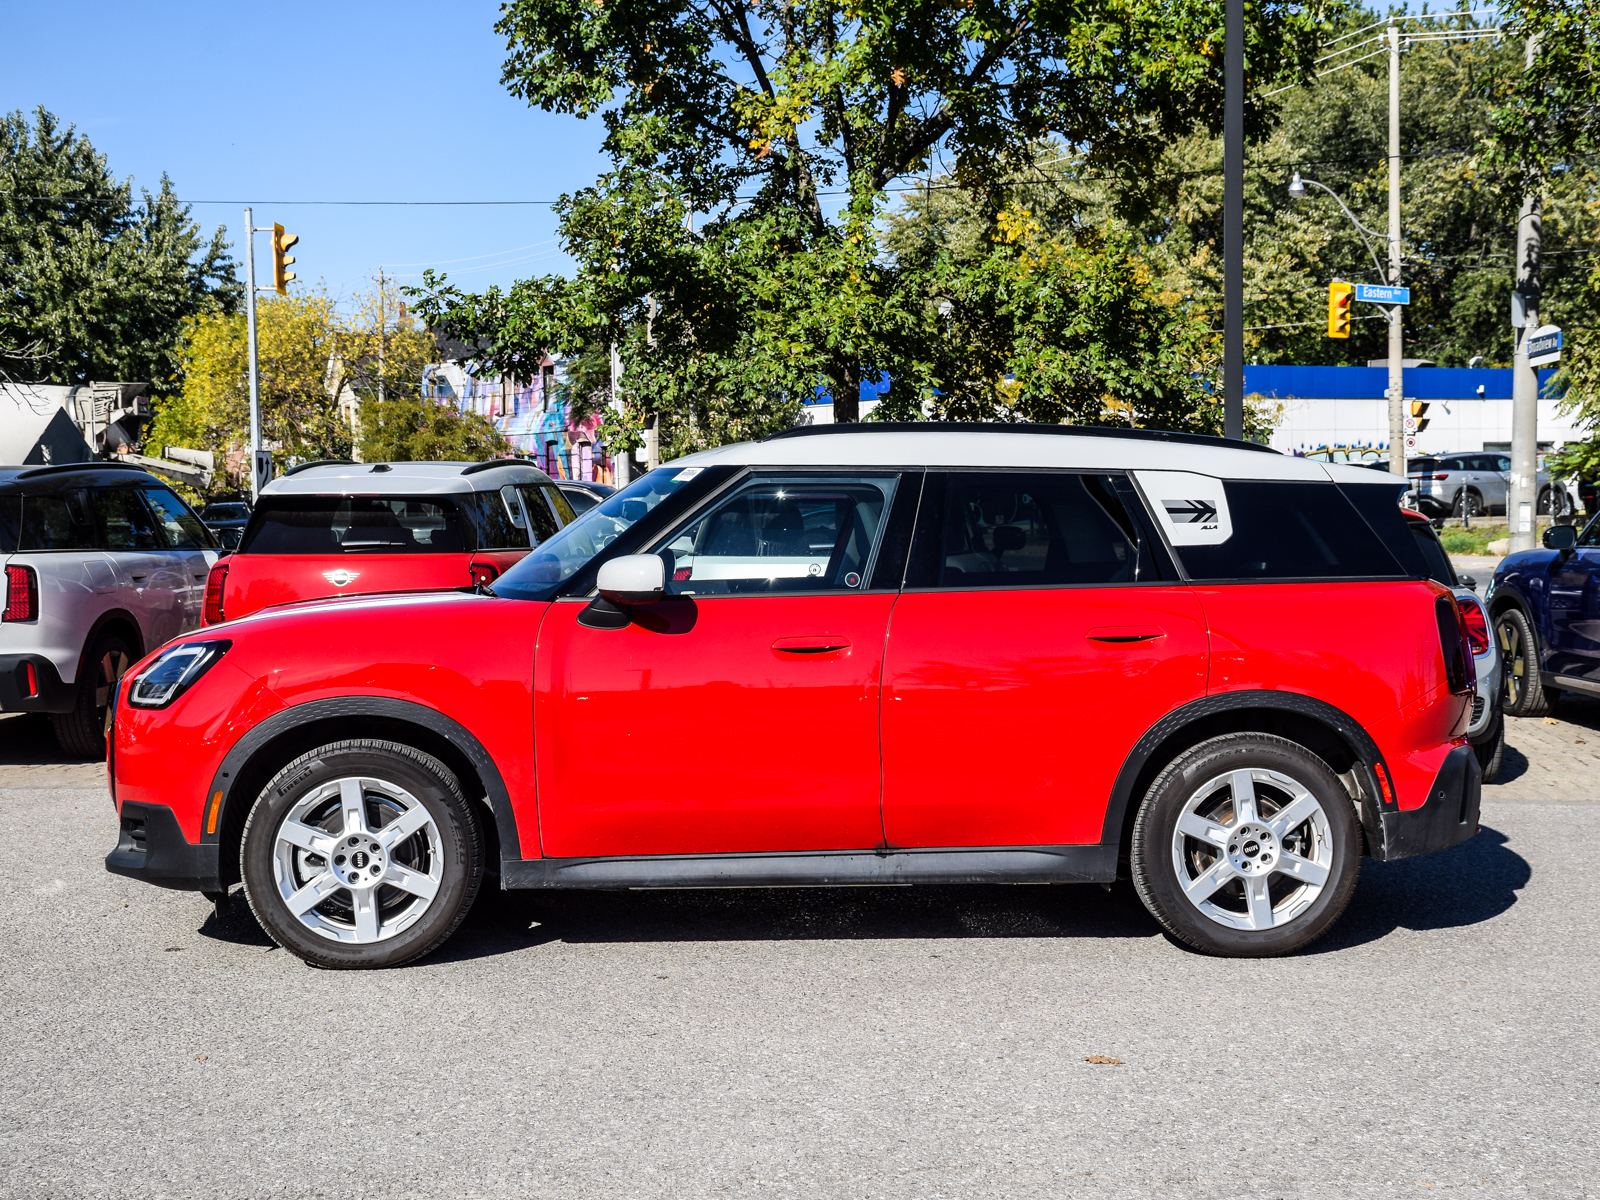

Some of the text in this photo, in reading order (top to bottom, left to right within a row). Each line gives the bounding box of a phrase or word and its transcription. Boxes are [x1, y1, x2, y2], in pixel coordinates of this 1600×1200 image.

[1363, 286, 1393, 299] Eastern
[276, 765, 314, 798] PIRELLI
[447, 812, 466, 865] ZERO
